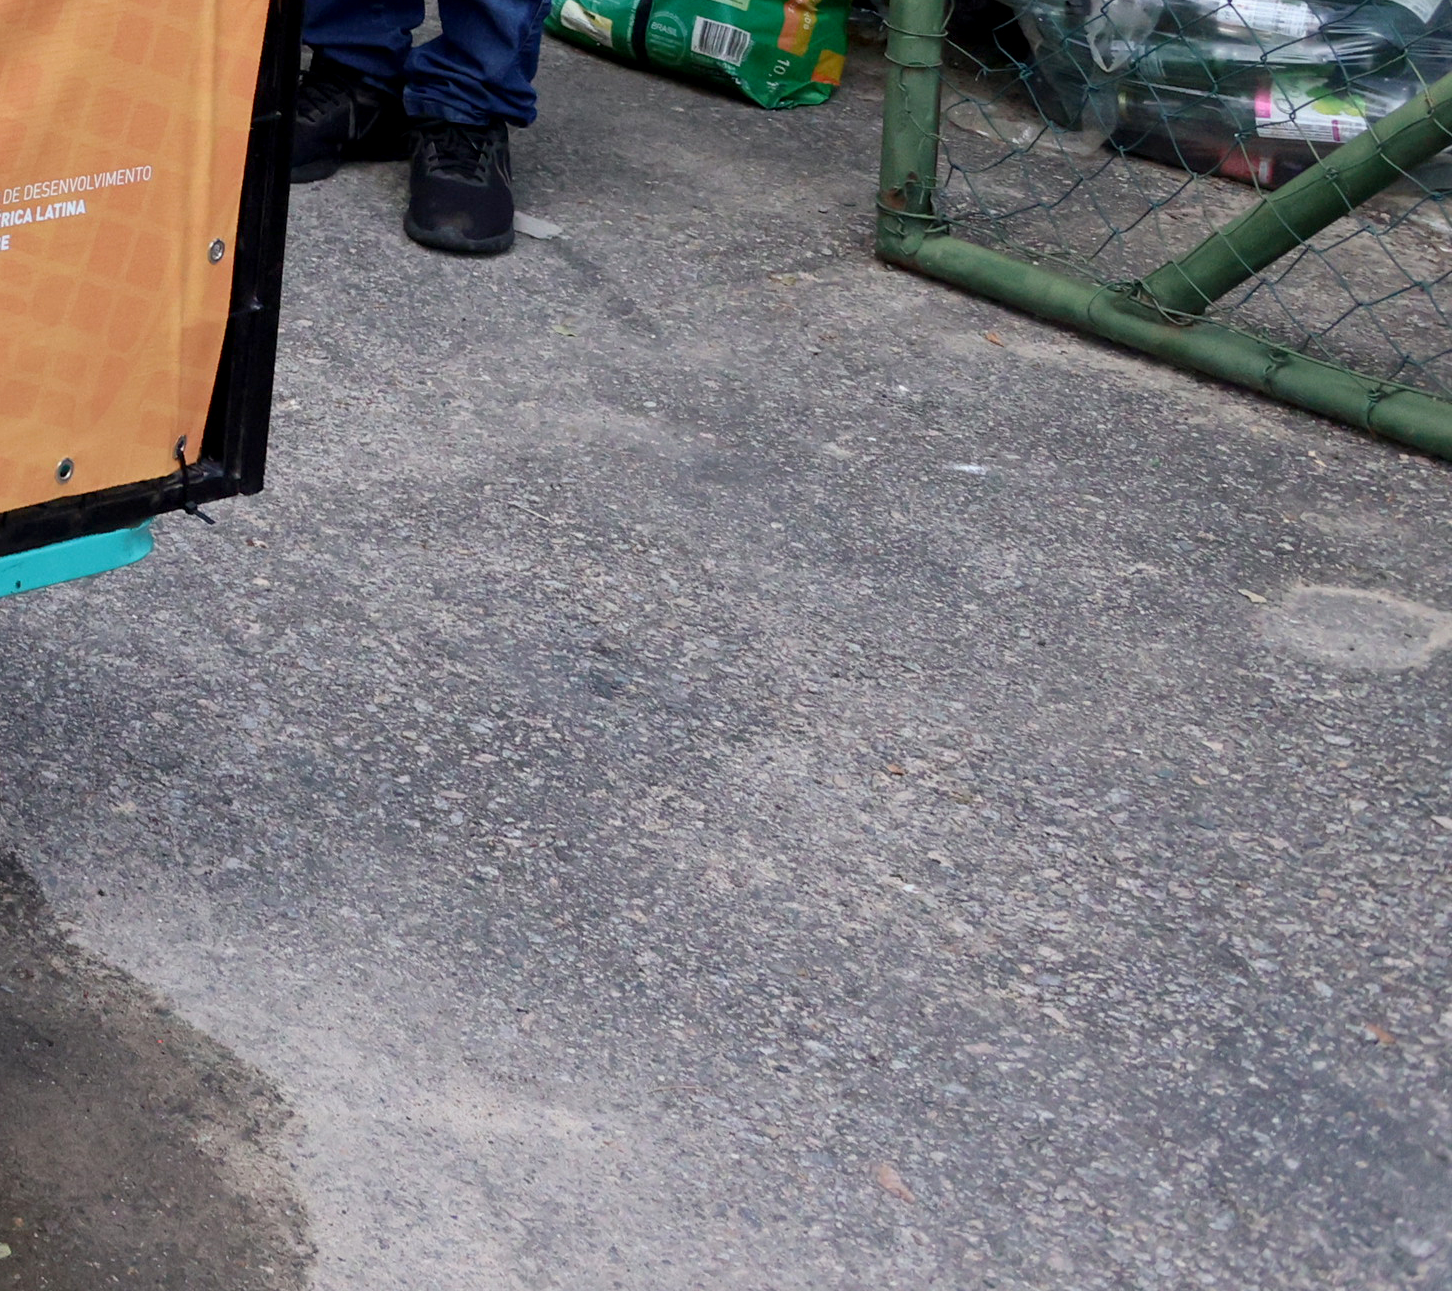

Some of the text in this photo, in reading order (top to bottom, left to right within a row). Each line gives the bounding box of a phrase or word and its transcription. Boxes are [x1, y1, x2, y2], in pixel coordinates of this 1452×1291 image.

[2, 186, 21, 206] DE
[23, 165, 153, 202] DESENVOLVIMENTO
[35, 199, 87, 222] LATINA
